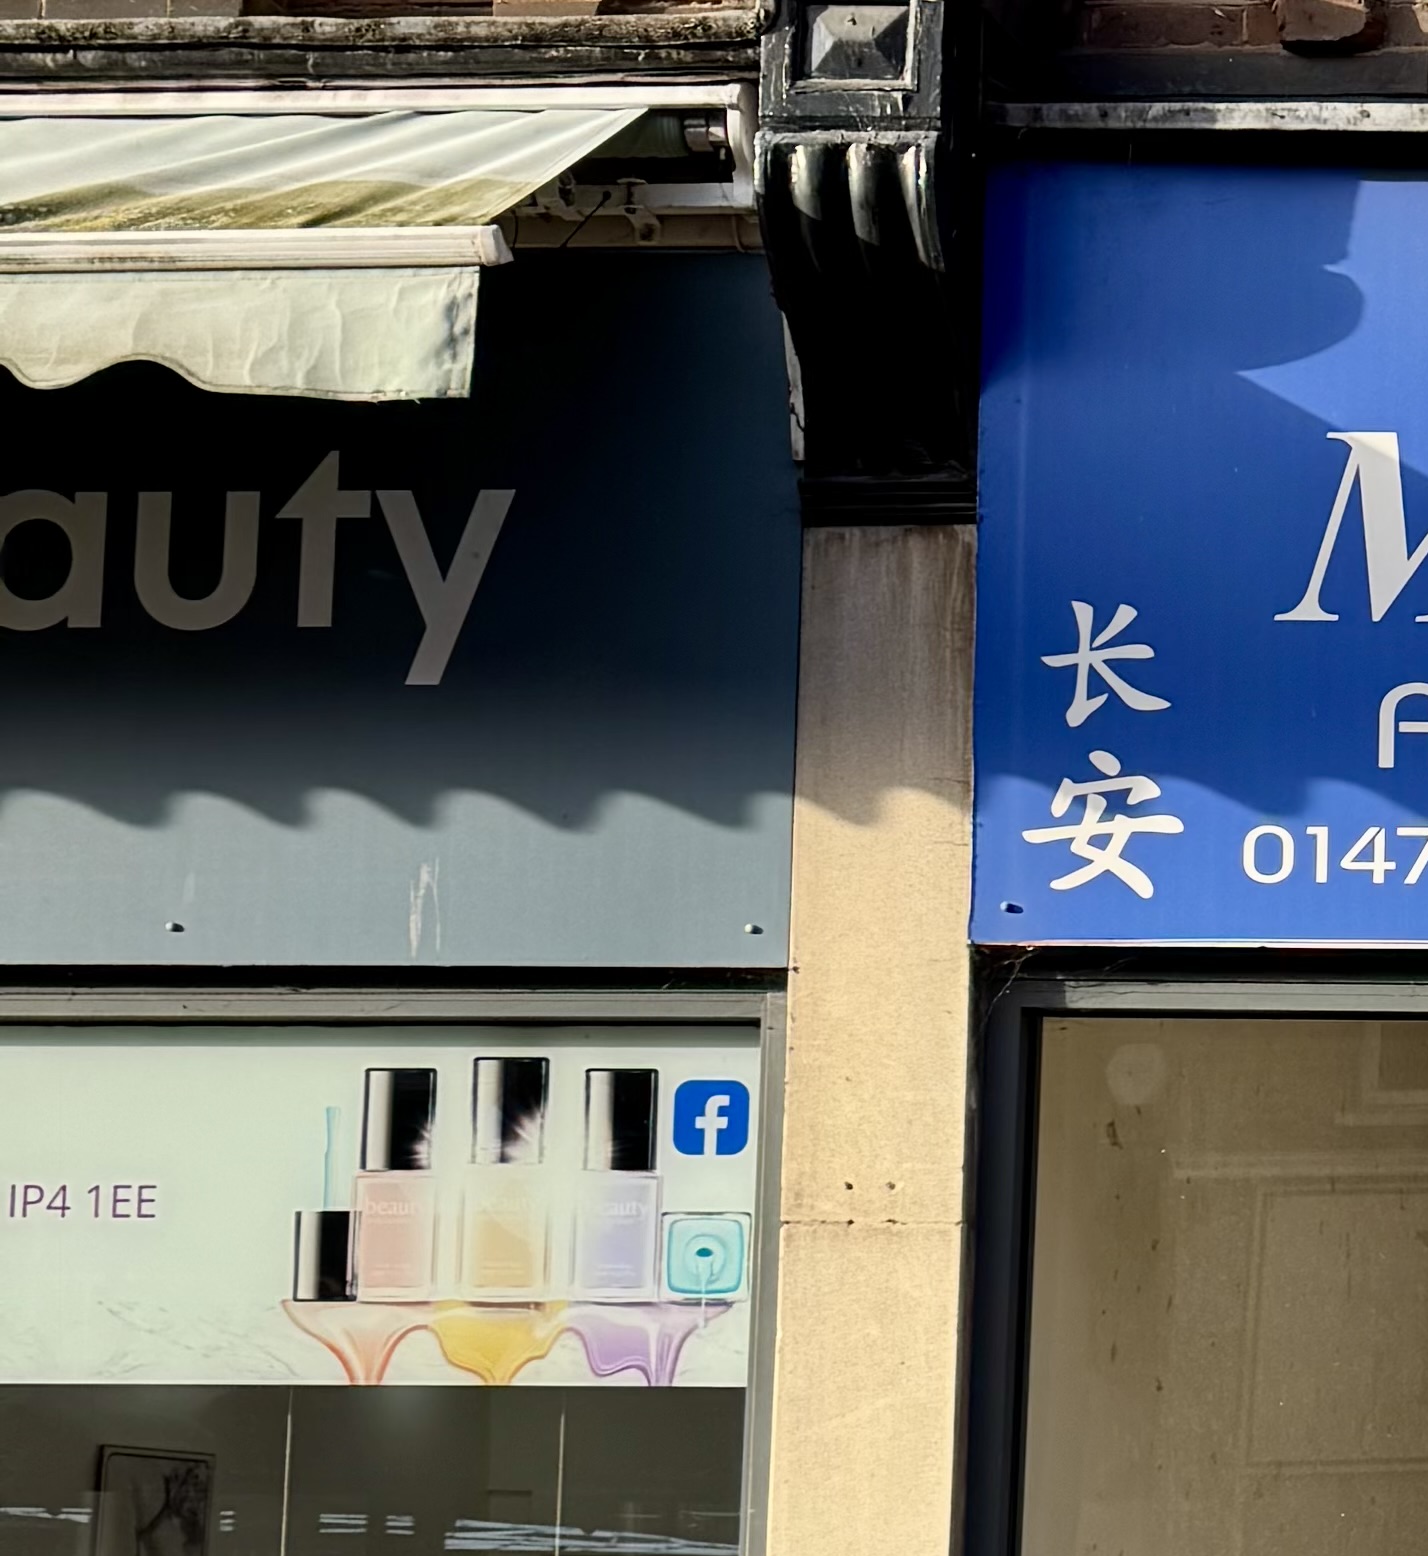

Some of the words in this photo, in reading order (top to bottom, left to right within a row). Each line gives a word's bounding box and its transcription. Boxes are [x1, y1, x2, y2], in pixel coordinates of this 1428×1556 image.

[1022, 598, 1184, 902] 长安
[7, 1183, 72, 1219] IP4
[90, 1183, 157, 1219] 1EE
